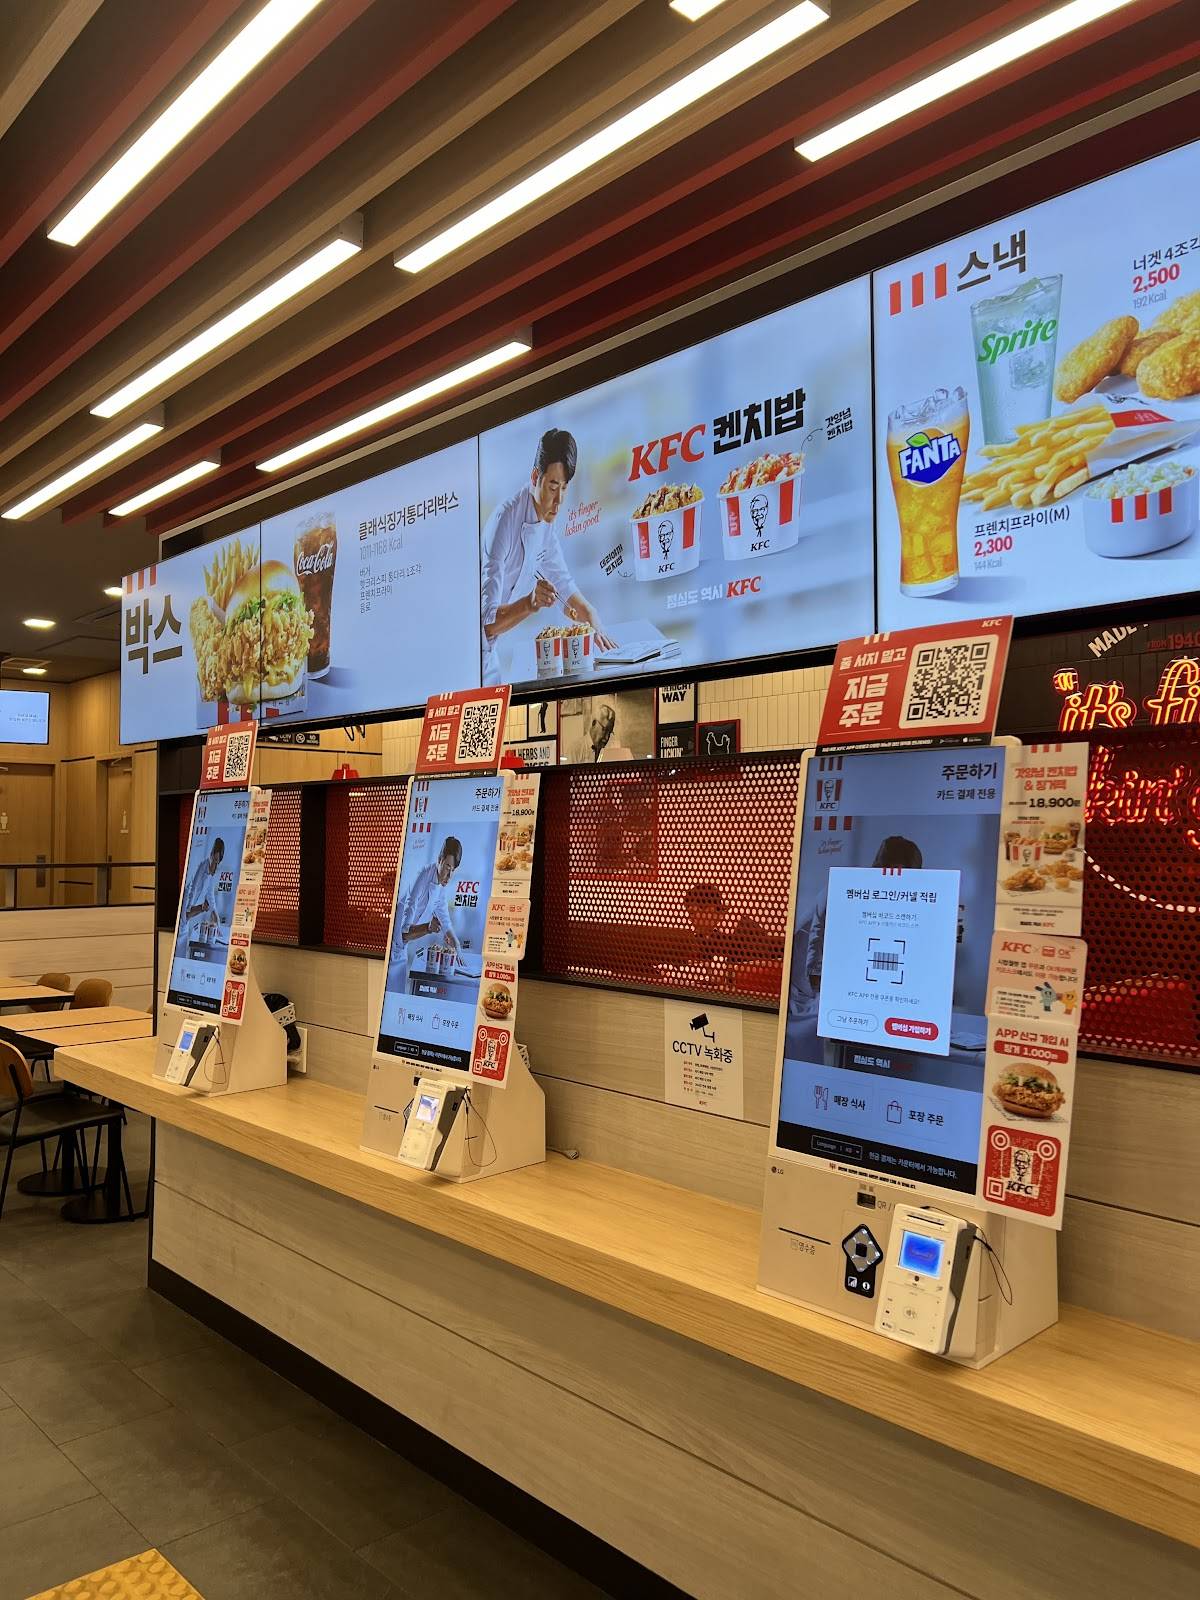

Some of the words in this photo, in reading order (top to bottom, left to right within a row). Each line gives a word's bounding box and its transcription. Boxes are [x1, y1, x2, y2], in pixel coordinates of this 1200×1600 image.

[957, 229, 1027, 292] 스낵
[1133, 249, 1161, 270] 너겟
[1132, 263, 1181, 293] 2,500
[977, 318, 1058, 365] Sprite
[628, 424, 706, 482] KFC
[713, 388, 806, 455] 켄치밥
[826, 420, 853, 440] 켄치밥
[899, 433, 962, 477] FANTA
[359, 491, 459, 540] 클래식징거통다리박스
[974, 505, 1070, 537] 프렌치프라이(M)
[750, 540, 770, 552] KFC
[974, 535, 1013, 557] 2,300
[658, 562, 676, 574] KFC
[726, 576, 762, 598] KFC
[981, 618, 1003, 628] KFC
[125, 595, 183, 675] 박스
[839, 656, 851, 671] 줄
[854, 652, 878, 668] 서지
[881, 647, 908, 664] 말고
[843, 672, 889, 700] 지금
[661, 691, 686, 703] WAY
[838, 700, 884, 728] 주문
[429, 723, 451, 741] 지금
[426, 743, 449, 762] 주문
[941, 762, 997, 781] 주문하기
[475, 786, 501, 799] 주문하기
[936, 789, 954, 800] 카드
[957, 789, 975, 800] 결제
[978, 788, 996, 799] 전용
[456, 881, 480, 893] KFC
[846, 888, 870, 900] 멤버십
[920, 892, 937, 903] 적립
[454, 894, 478, 908] 켄치밥
[1000, 941, 1032, 954] KFC
[995, 1027, 1019, 1039] APP
[1020, 1031, 1037, 1042] 신규
[1059, 1037, 1069, 1047] 시
[672, 1040, 702, 1057] CCTV
[704, 1045, 733, 1064] 녹화중
[833, 1095, 848, 1107] 매장
[850, 1098, 865, 1111] 식사
[908, 1110, 925, 1122] 포장
[927, 1113, 945, 1126] 주문
[1006, 1180, 1033, 1195] KFC
